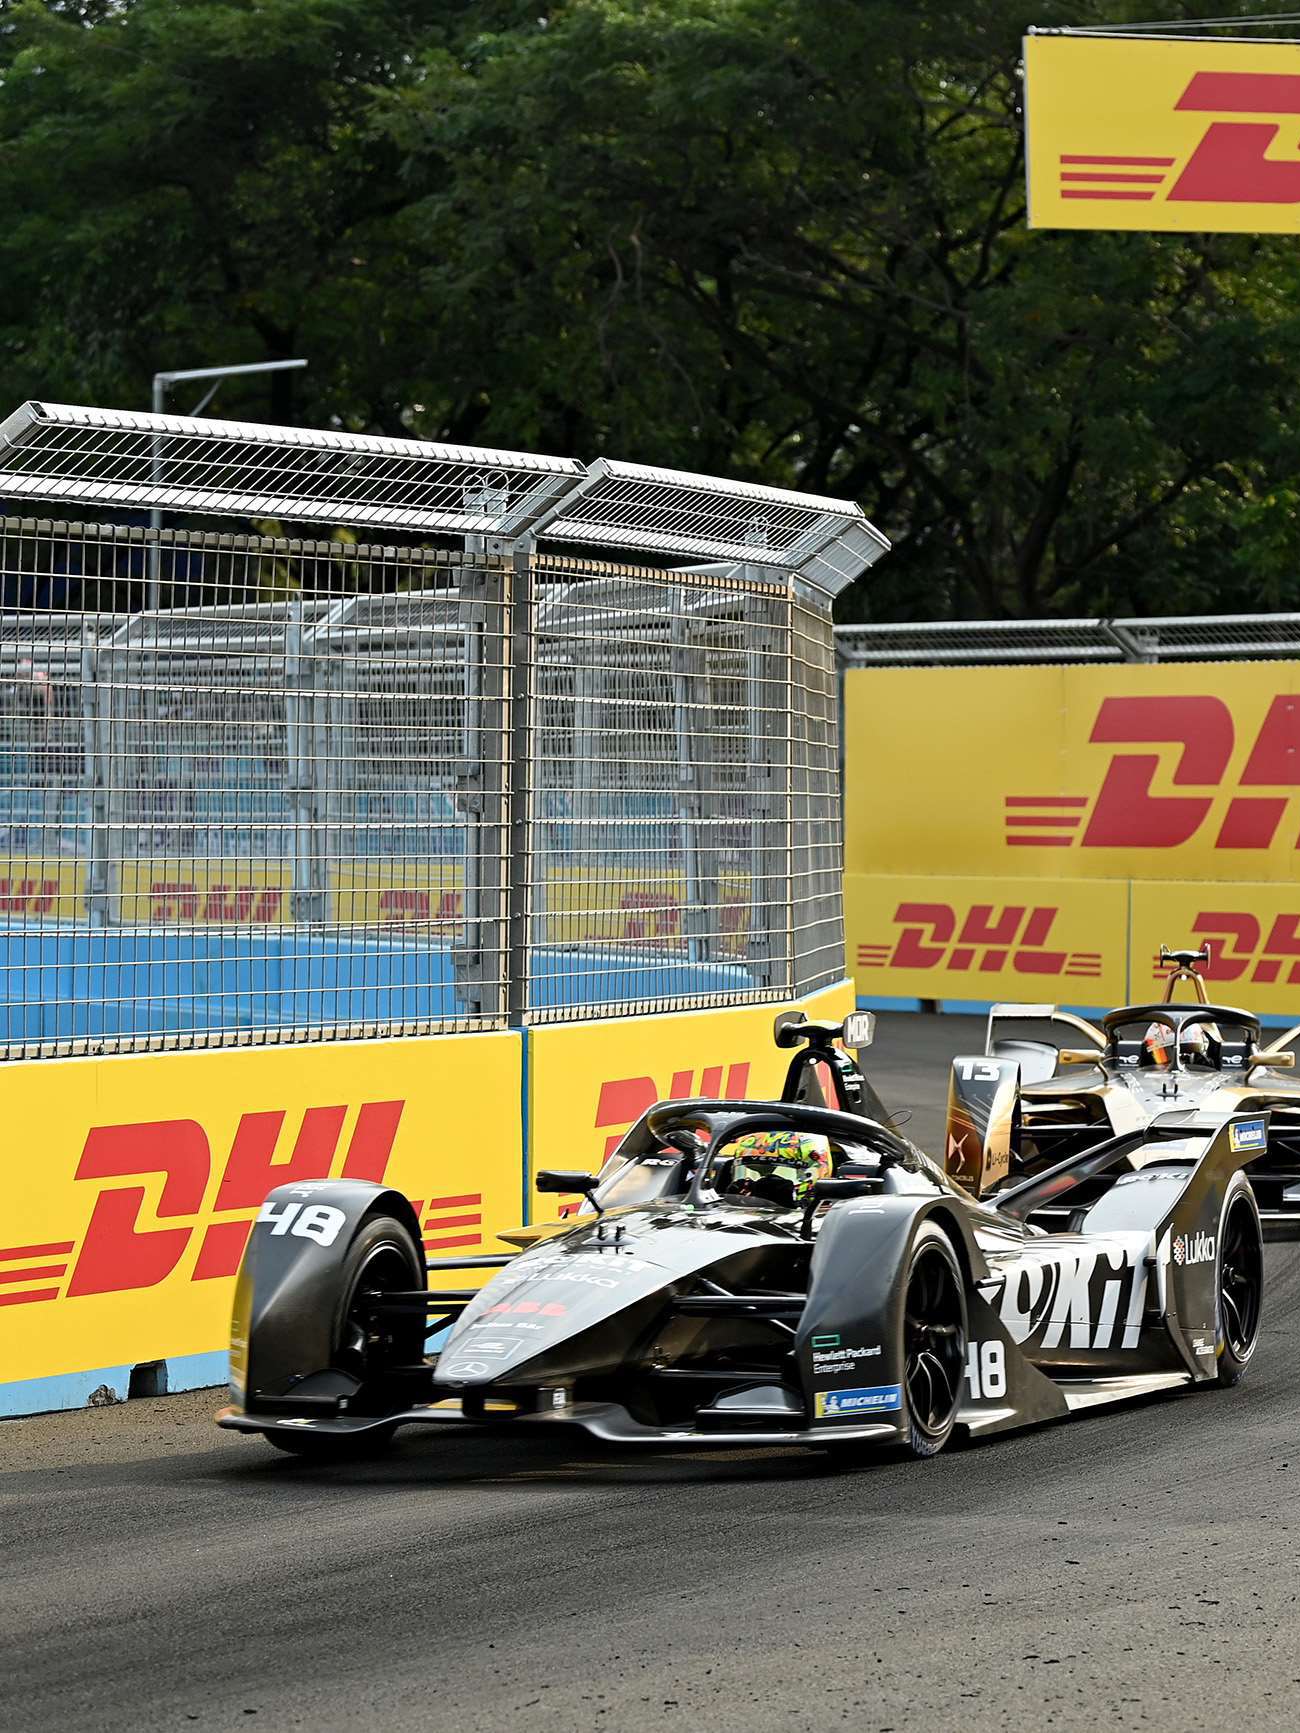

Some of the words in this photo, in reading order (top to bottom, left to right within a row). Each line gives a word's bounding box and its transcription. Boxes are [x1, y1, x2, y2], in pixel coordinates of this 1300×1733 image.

[889, 902, 1068, 974] DHL
[958, 1061, 1000, 1082] 13
[255, 1201, 347, 1247] 48
[1184, 1230, 1216, 1265] Lukka
[978, 1246, 1150, 1349] OKiT
[812, 1351, 845, 1362] Hewlett
[846, 1344, 882, 1358] Packard
[813, 1361, 856, 1374] Enterprise
[840, 1393, 898, 1408] MICHELIN
